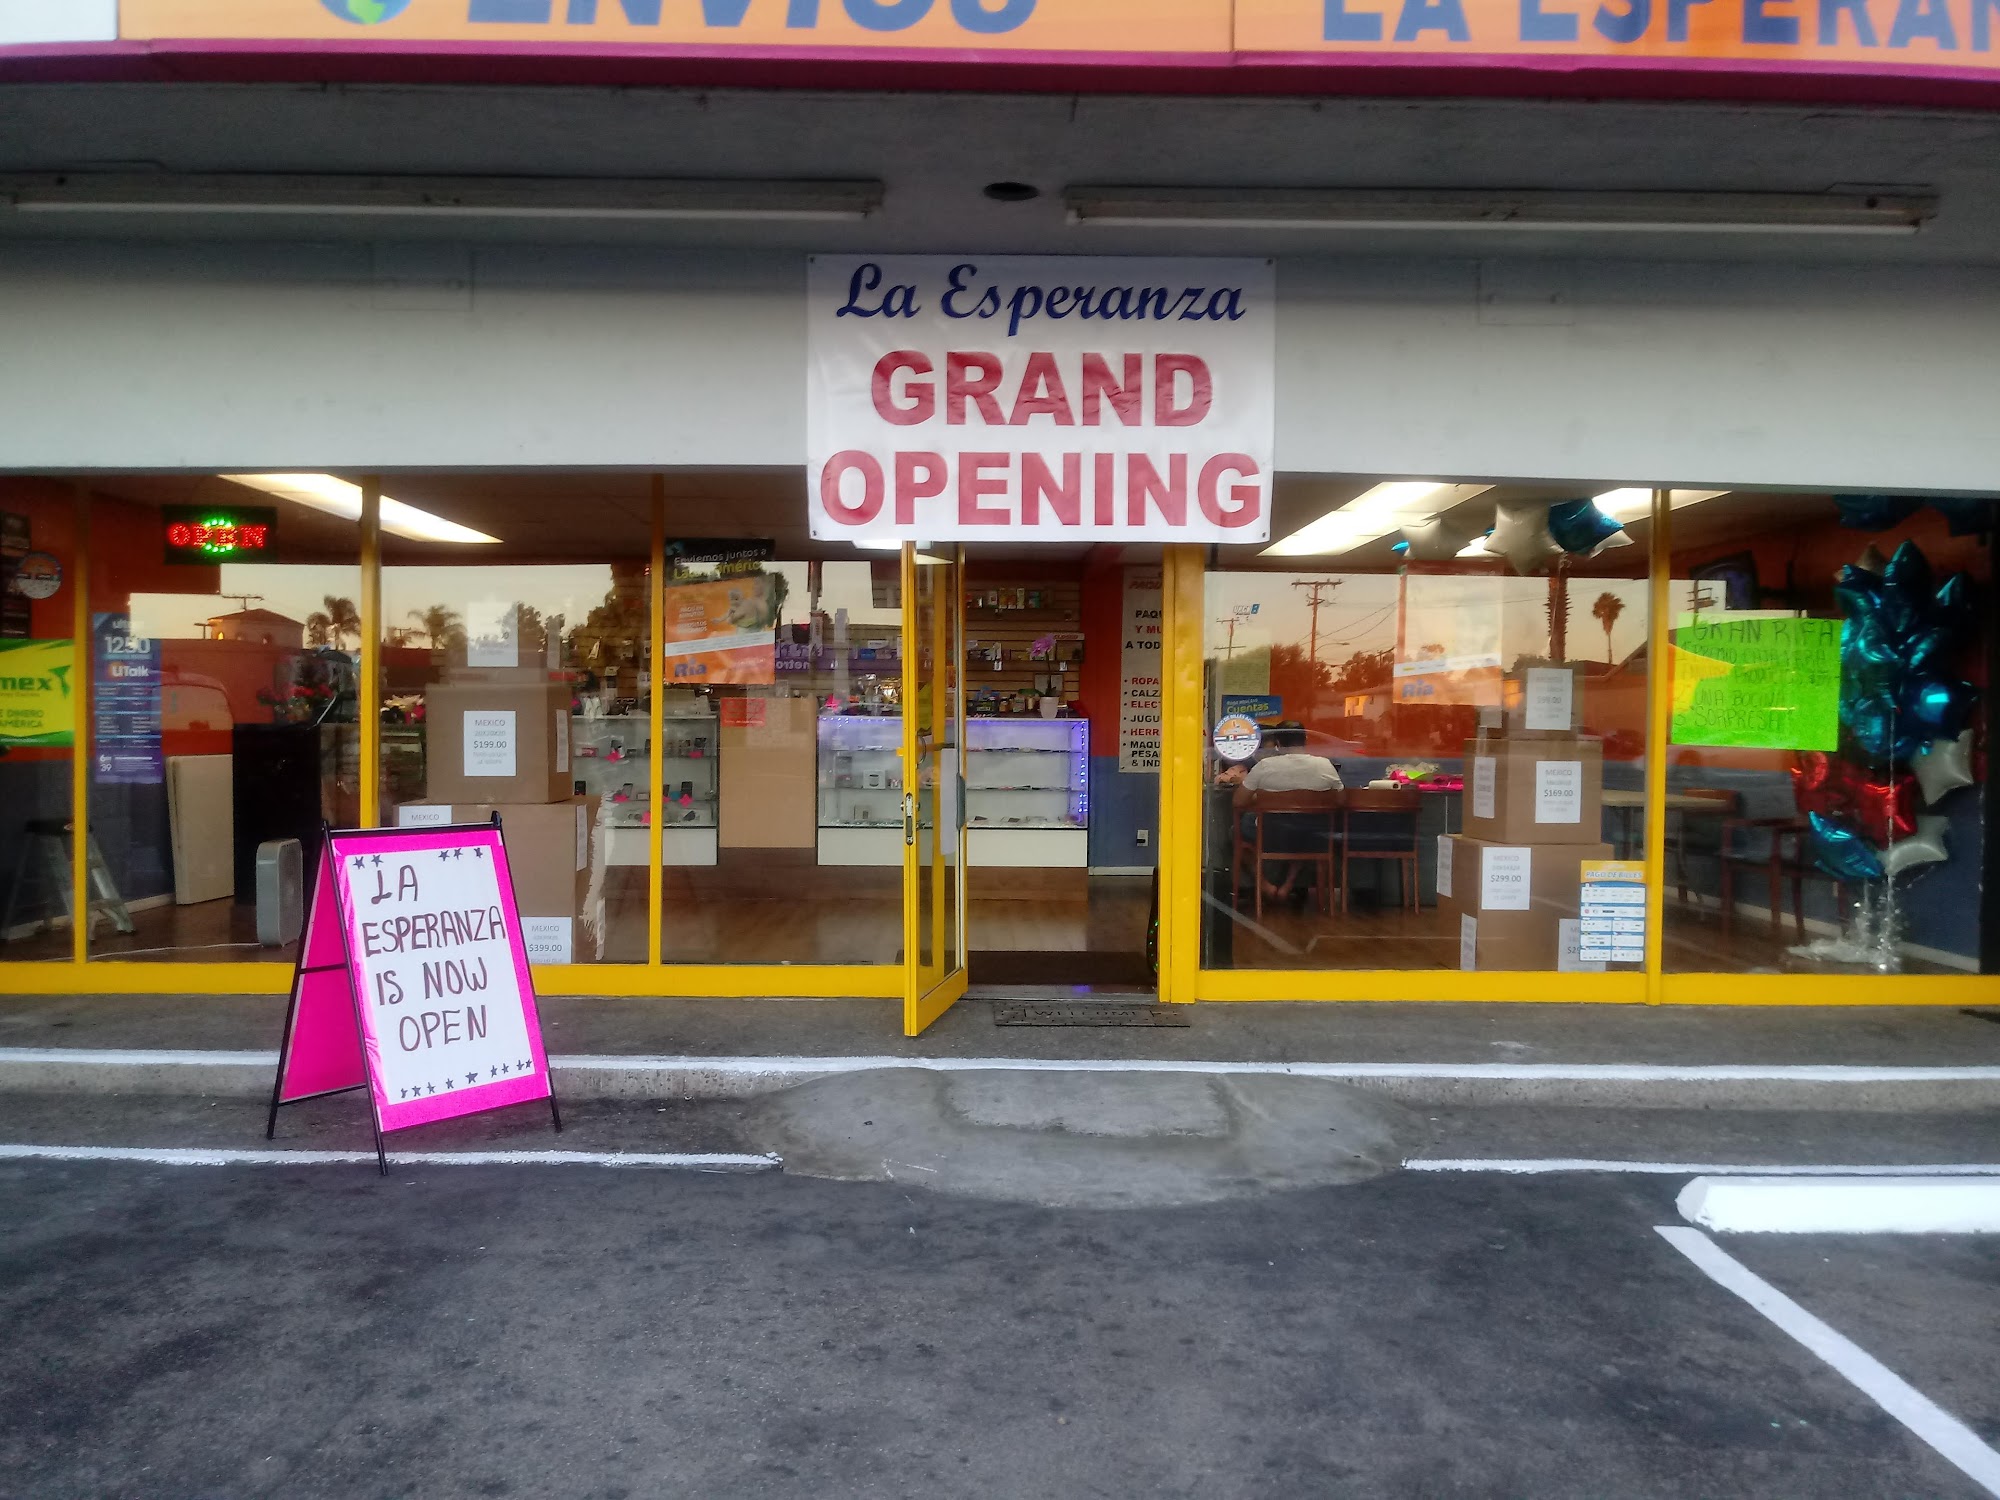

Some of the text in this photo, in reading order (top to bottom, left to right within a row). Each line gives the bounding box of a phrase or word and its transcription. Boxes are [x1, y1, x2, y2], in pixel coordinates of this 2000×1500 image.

[836, 262, 1247, 337] La Esperanza
[871, 350, 1213, 427] GRAND
[820, 449, 1261, 528] OPENING
[168, 523, 267, 549] OPEN
[674, 547, 768, 566] Enviemos juntos a
[673, 560, 763, 579] Laaméric
[1136, 625, 1143, 633] Y
[1693, 619, 1834, 647] GRAN RIFA
[1125, 640, 1134, 649] A
[674, 657, 707, 678] Ria
[1131, 677, 1160, 685] ROPA
[1131, 689, 1161, 697] CALZ
[1401, 678, 1435, 699] Ria
[1226, 702, 1269, 714] Cuentas
[475, 719, 506, 727] MEXICO
[1130, 715, 1160, 723] JUGU
[1130, 728, 1160, 736] HERR
[473, 740, 508, 750] $199.00
[1130, 741, 1160, 749] MAQU
[1131, 750, 1160, 758] PESA
[1131, 759, 1139, 767] &
[1544, 789, 1574, 799] $169.00
[1490, 874, 1522, 883] $299.00
[371, 864, 418, 905] LA
[361, 905, 507, 958] ESPERANZA
[528, 943, 563, 952] $399.00
[376, 957, 488, 1006] IS NOW
[399, 1004, 487, 1052] OPEN
